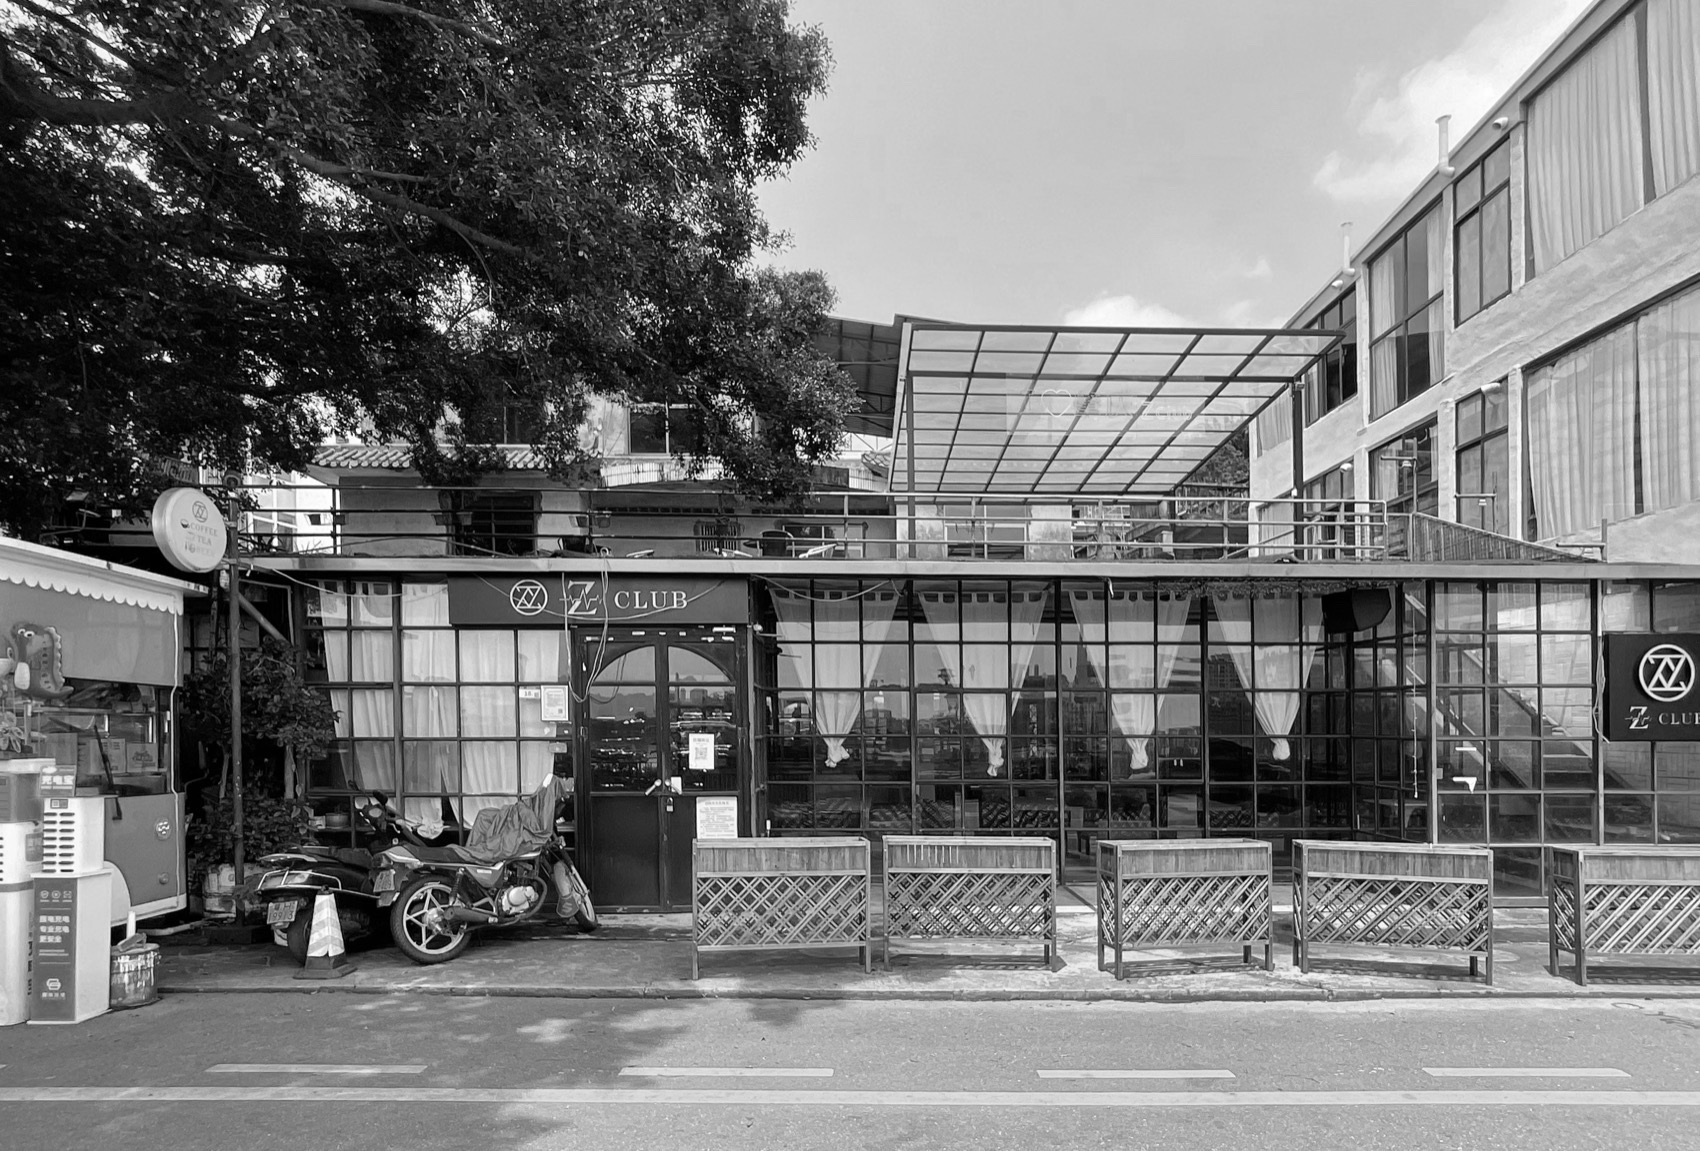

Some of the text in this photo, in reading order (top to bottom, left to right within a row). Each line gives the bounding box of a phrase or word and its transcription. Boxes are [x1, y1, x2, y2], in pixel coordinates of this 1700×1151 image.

[190, 522, 218, 537] COFFEE
[197, 535, 212, 546] TEA
[614, 590, 688, 609] CLUB
[41, 775, 74, 785] 充电宝
